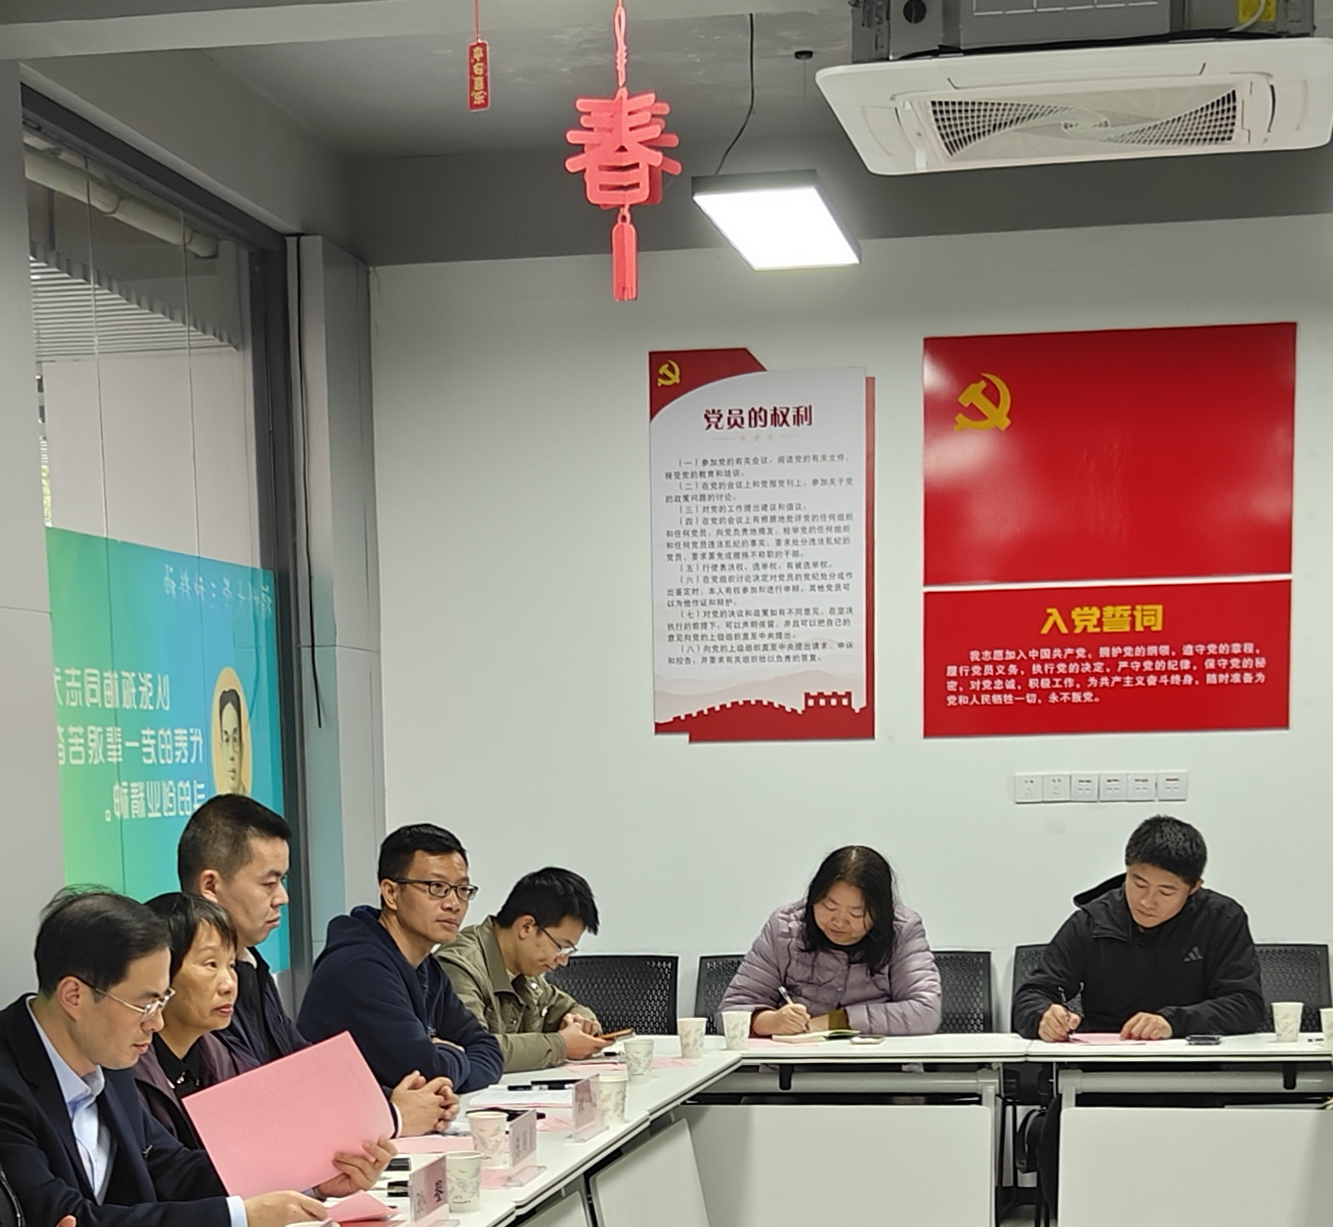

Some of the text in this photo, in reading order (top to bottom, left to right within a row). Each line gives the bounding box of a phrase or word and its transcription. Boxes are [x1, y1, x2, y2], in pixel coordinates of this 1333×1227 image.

[703, 404, 813, 431] 党员的权利
[1039, 603, 1164, 635] 入党誓词
